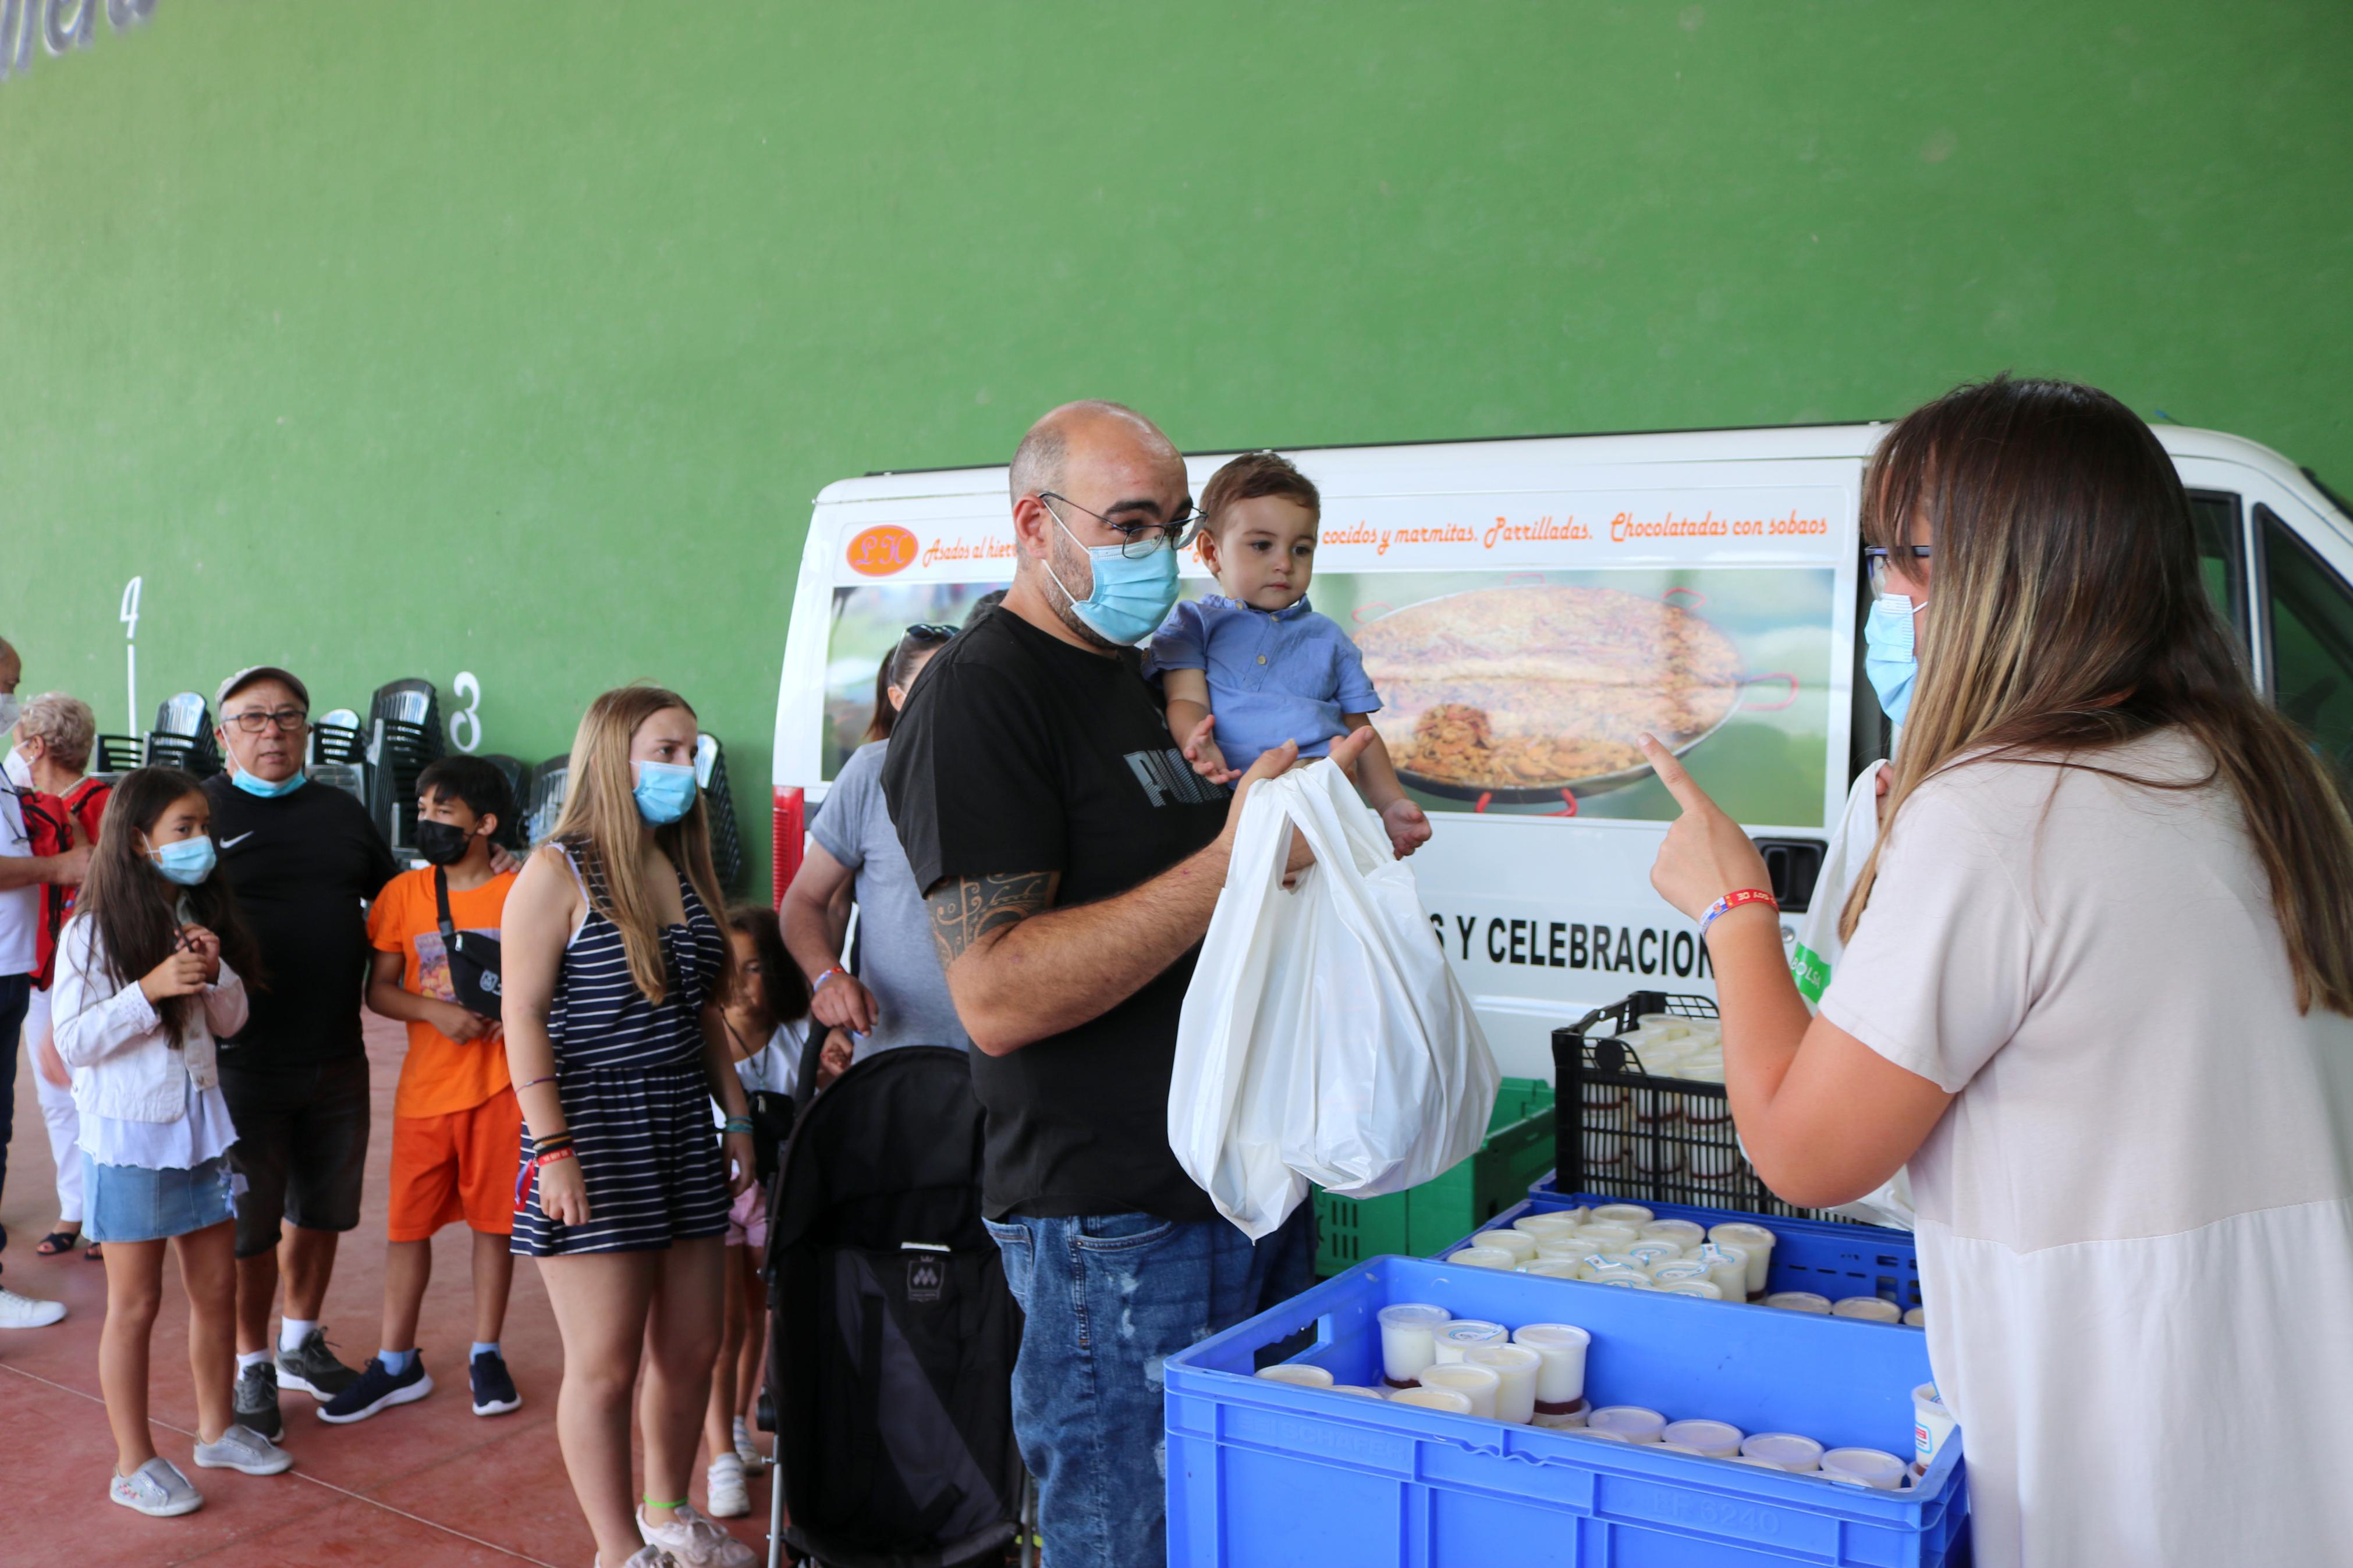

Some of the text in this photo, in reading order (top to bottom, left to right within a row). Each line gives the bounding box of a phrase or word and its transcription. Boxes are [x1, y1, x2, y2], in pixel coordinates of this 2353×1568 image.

[922, 537, 970, 568] Asados
[972, 536, 986, 559] al
[1322, 509, 1827, 556] cocidos y marmitas. Parrilladas. Chocolatadas con sobaos
[449, 671, 481, 753] 3
[1456, 915, 1477, 960] Y
[1700, 1498, 1781, 1536] 6240
